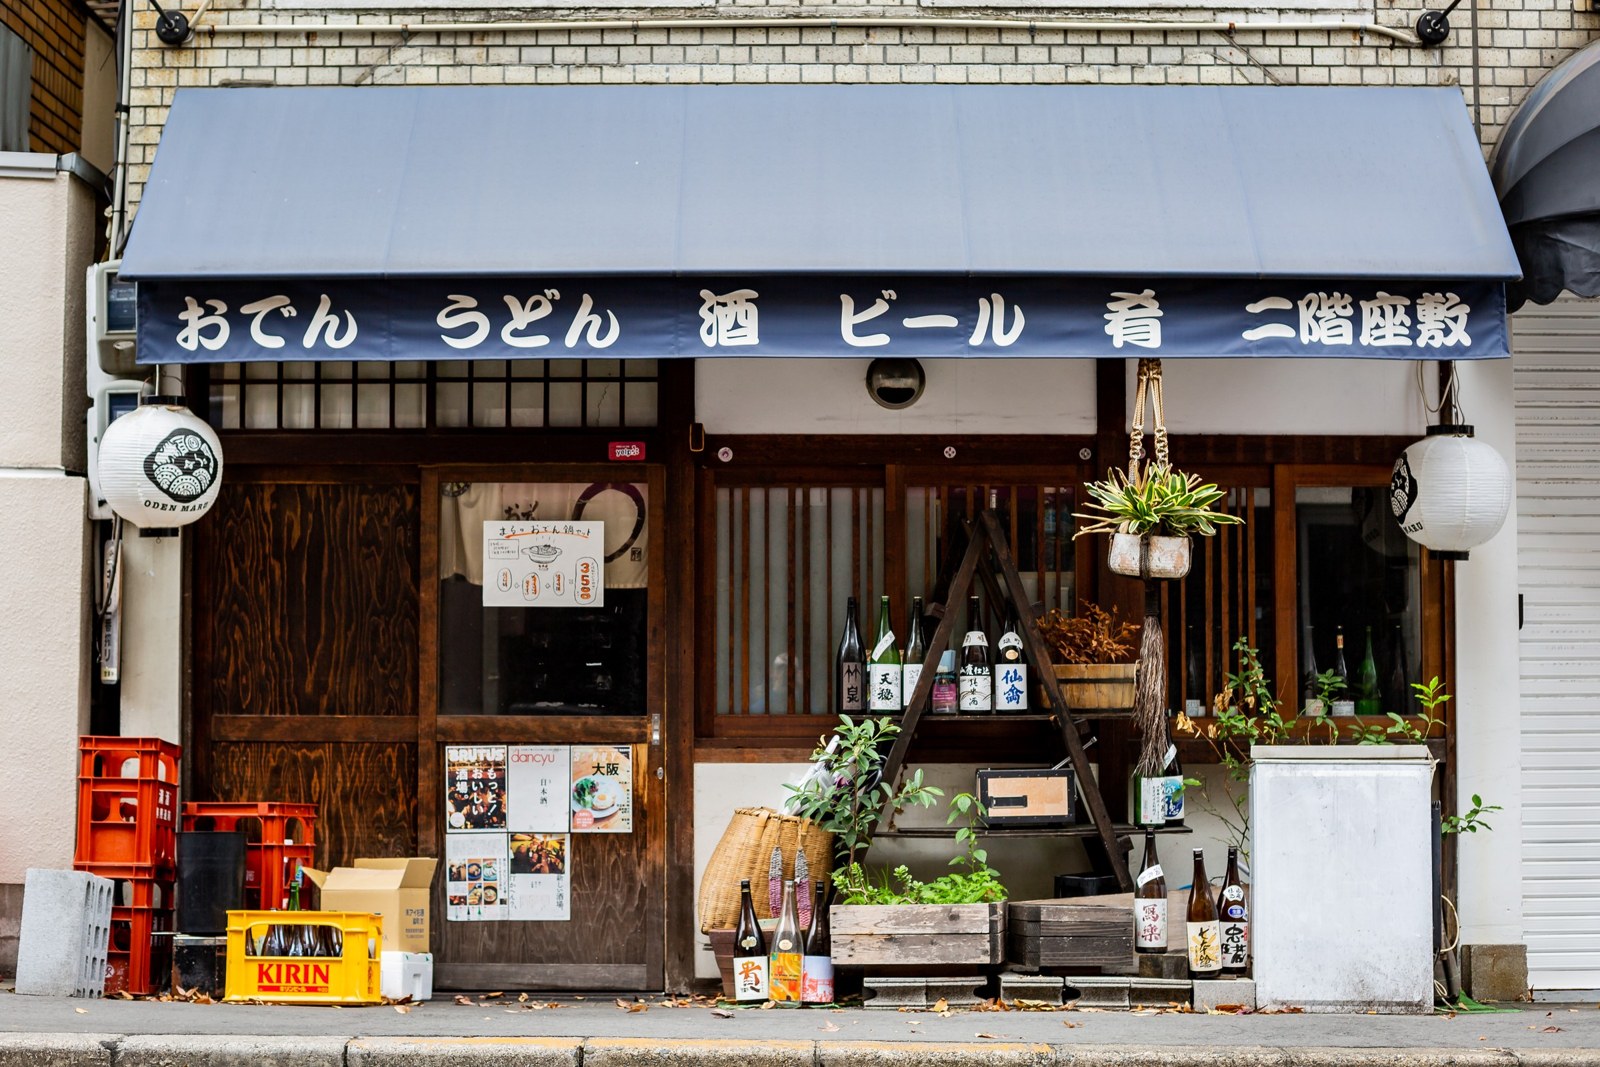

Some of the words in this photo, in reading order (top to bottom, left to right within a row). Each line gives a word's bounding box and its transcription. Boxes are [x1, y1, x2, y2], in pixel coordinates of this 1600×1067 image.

[176, 293, 358, 351] おでん
[436, 288, 620, 349] うどん
[699, 289, 760, 348] 酒
[840, 289, 1025, 347] ビール
[1103, 288, 1164, 349] 肴
[1241, 291, 1473, 348] 二階座敷
[143, 499, 177, 512] ODEN
[844, 664, 861, 704] 竹泉
[448, 748, 505, 762] BRUTUS
[511, 749, 555, 767] dancyu
[592, 763, 620, 776] 大阪
[471, 768, 484, 816] おいしい
[540, 778, 548, 805] 日本酒
[257, 963, 330, 984] KIRIN
